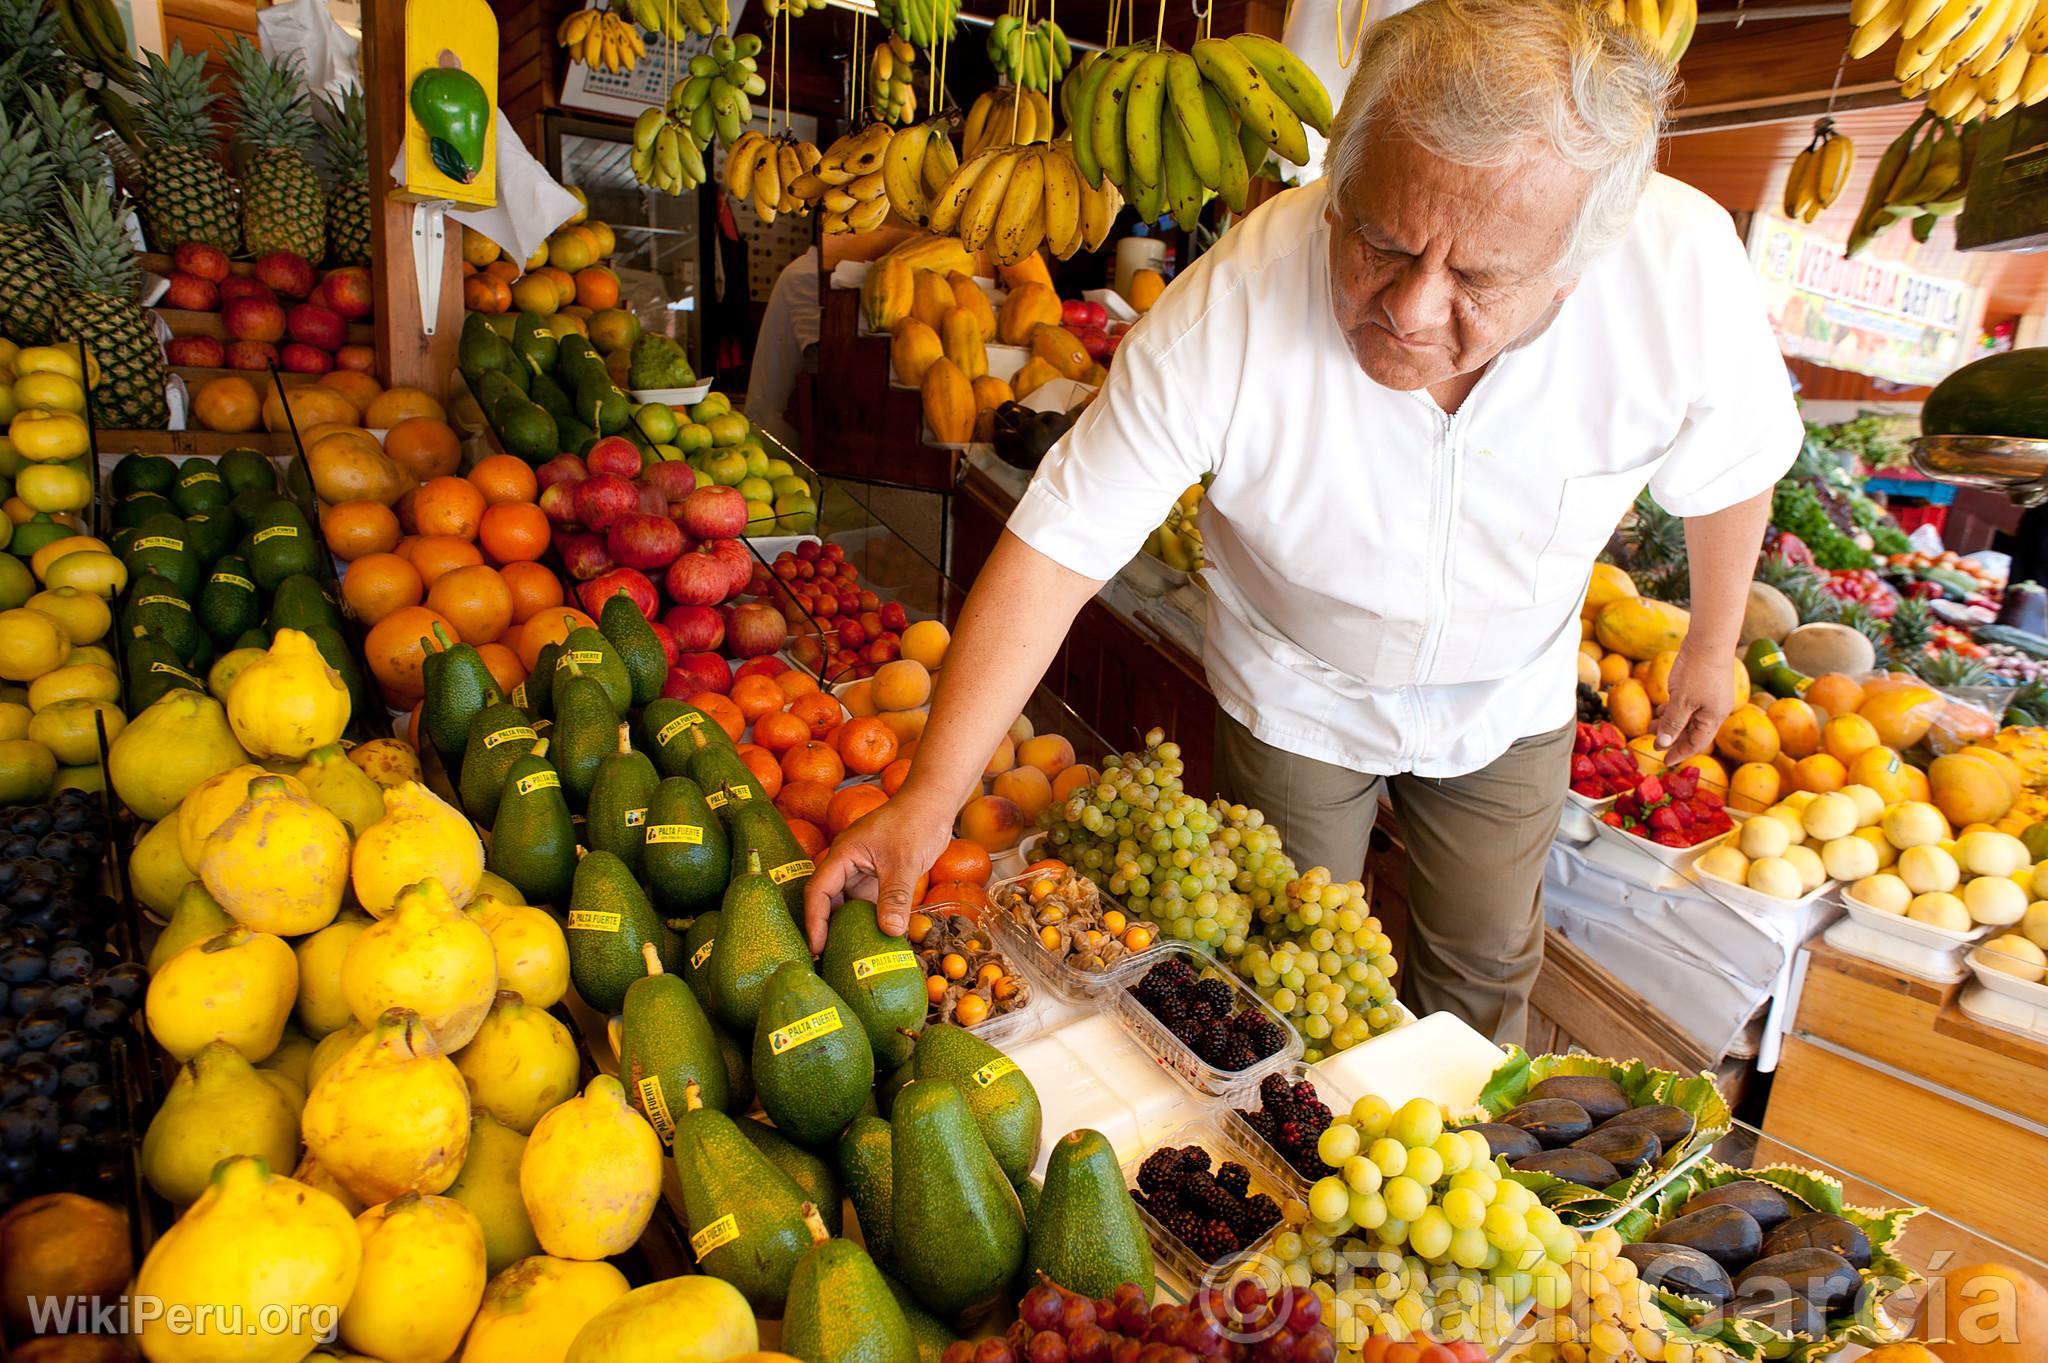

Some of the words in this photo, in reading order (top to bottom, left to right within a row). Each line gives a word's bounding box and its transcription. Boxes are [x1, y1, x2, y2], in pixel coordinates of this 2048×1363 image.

[498, 729, 515, 738] PALTA
[666, 720, 681, 734] PALTA
[658, 826, 676, 836] PALTA
[678, 826, 700, 837] FUERTE
[785, 862, 802, 874] PALTA
[576, 912, 592, 922] PALTA
[592, 913, 617, 925] FUERTE
[871, 955, 891, 968] PALTA
[891, 952, 914, 964] FUERTE
[788, 1020, 812, 1038] PALTA
[811, 1010, 837, 1028] FUERTE
[643, 1081, 658, 1110] FUERTE
[651, 1110, 670, 1132] PALTA
[706, 1219, 732, 1241] FUERTE
